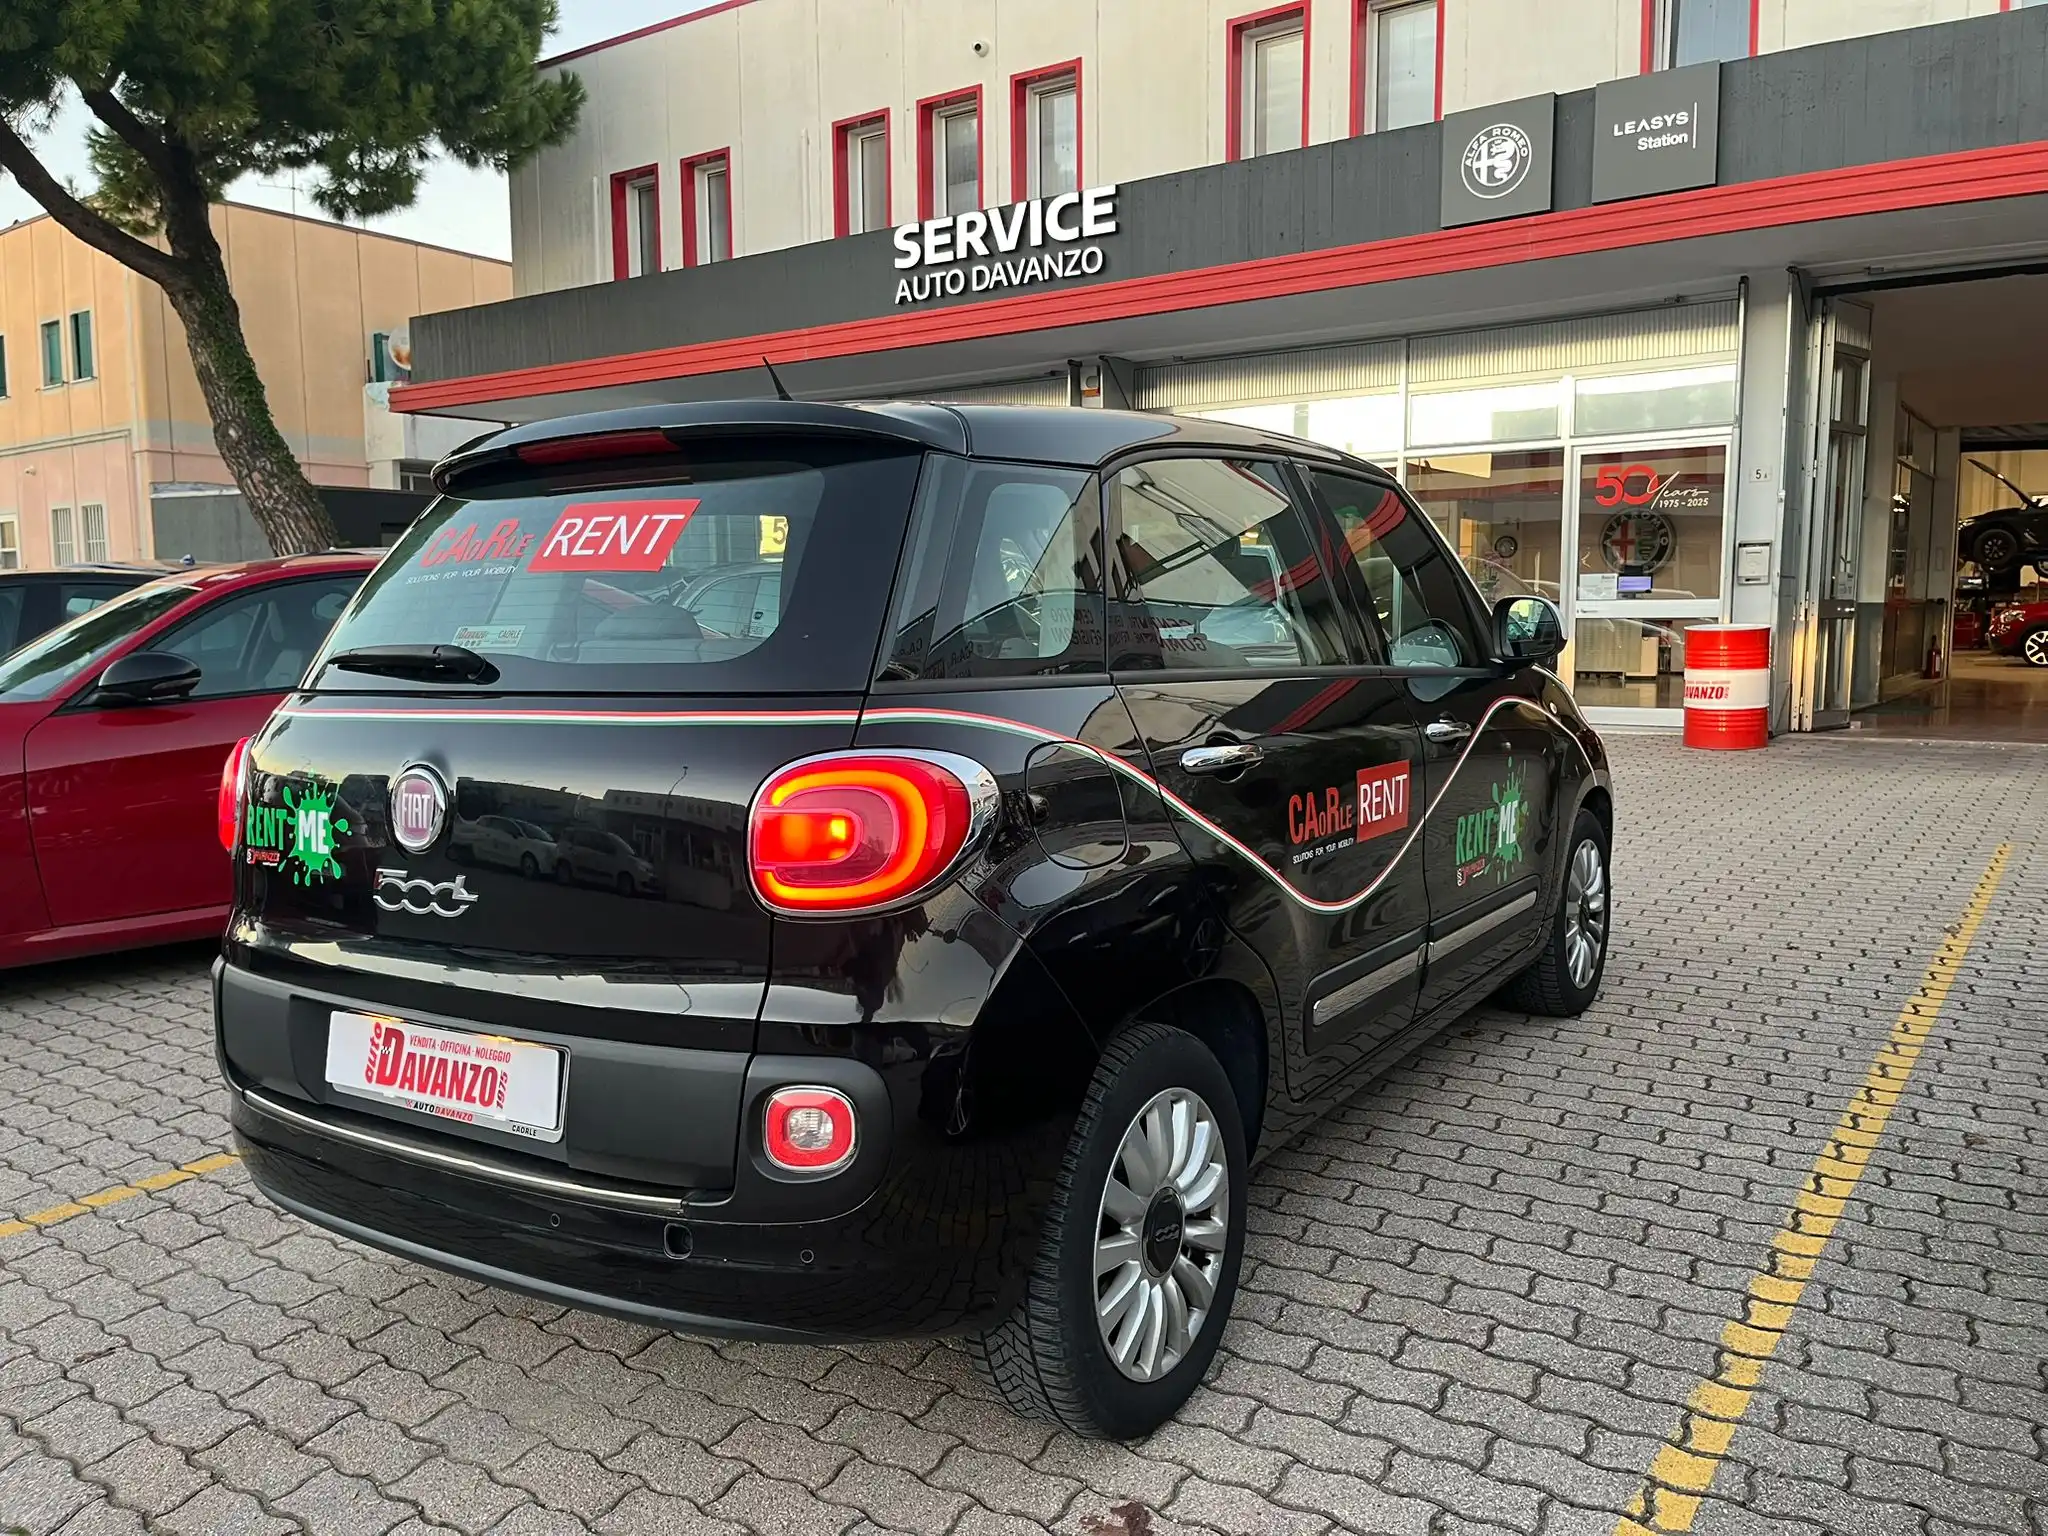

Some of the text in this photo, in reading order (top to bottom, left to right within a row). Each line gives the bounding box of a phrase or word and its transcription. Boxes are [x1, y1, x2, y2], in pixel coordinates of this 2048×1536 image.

[1613, 111, 1689, 137] LEASYS
[1637, 133, 1688, 151] Station
[1465, 128, 1528, 167] ALFA ROMEO
[893, 184, 1116, 269] SERVICE
[894, 246, 1104, 305] AUTO DAVANZO
[1595, 464, 1710, 510] 50 Years
[1755, 468, 1762, 480] 5
[543, 514, 685, 557] RENT
[406, 564, 519, 585] SOLUTIONS FOR YOUR MOBILITY
[402, 793, 431, 829] FIAT
[1360, 774, 1407, 825] RENT
[298, 809, 329, 854] ME
[1498, 800, 1518, 848] ME
[365, 1021, 383, 1085] auto
[376, 1027, 498, 1108] DAVANZO
[410, 1035, 511, 1064] VENDITA OFFICINA NOLEGGIO
[496, 1069, 509, 1110] 1975
[512, 1124, 537, 1137] CAORLE
